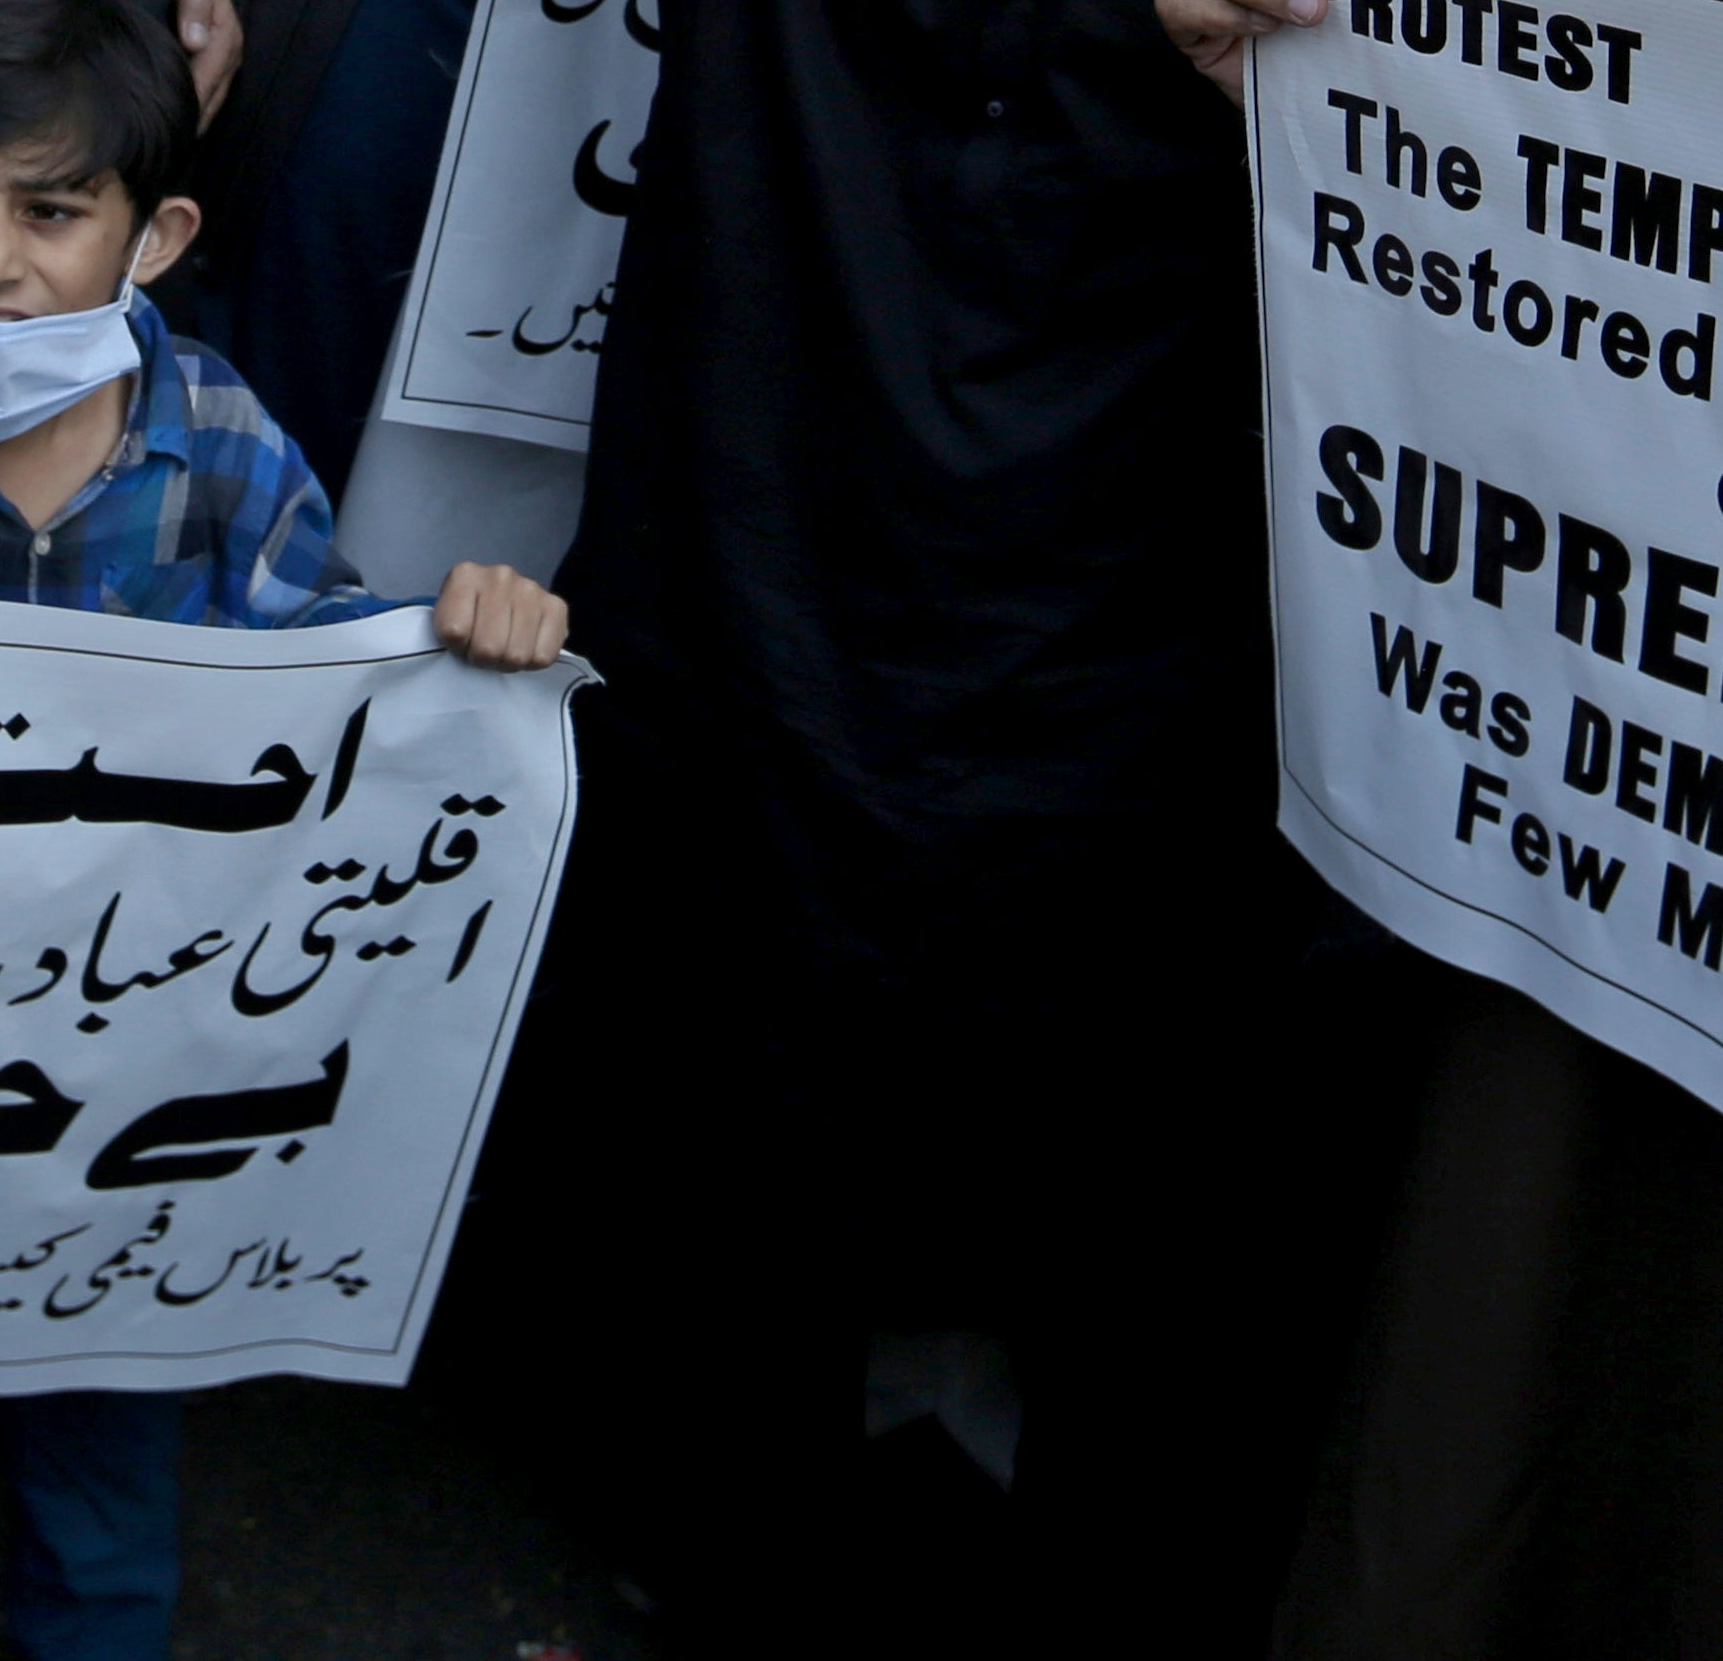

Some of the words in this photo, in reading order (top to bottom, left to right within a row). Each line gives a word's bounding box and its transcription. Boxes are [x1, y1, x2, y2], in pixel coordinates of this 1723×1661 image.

[1326, 86, 1483, 212] The
[1310, 189, 1717, 404] Restored
[1369, 611, 1532, 759] Was
[229, 792, 506, 1017] اقلیتی
[1454, 761, 1627, 916] Few
[83, 1037, 351, 1191] بے
[316, 1240, 372, 1301] پر
